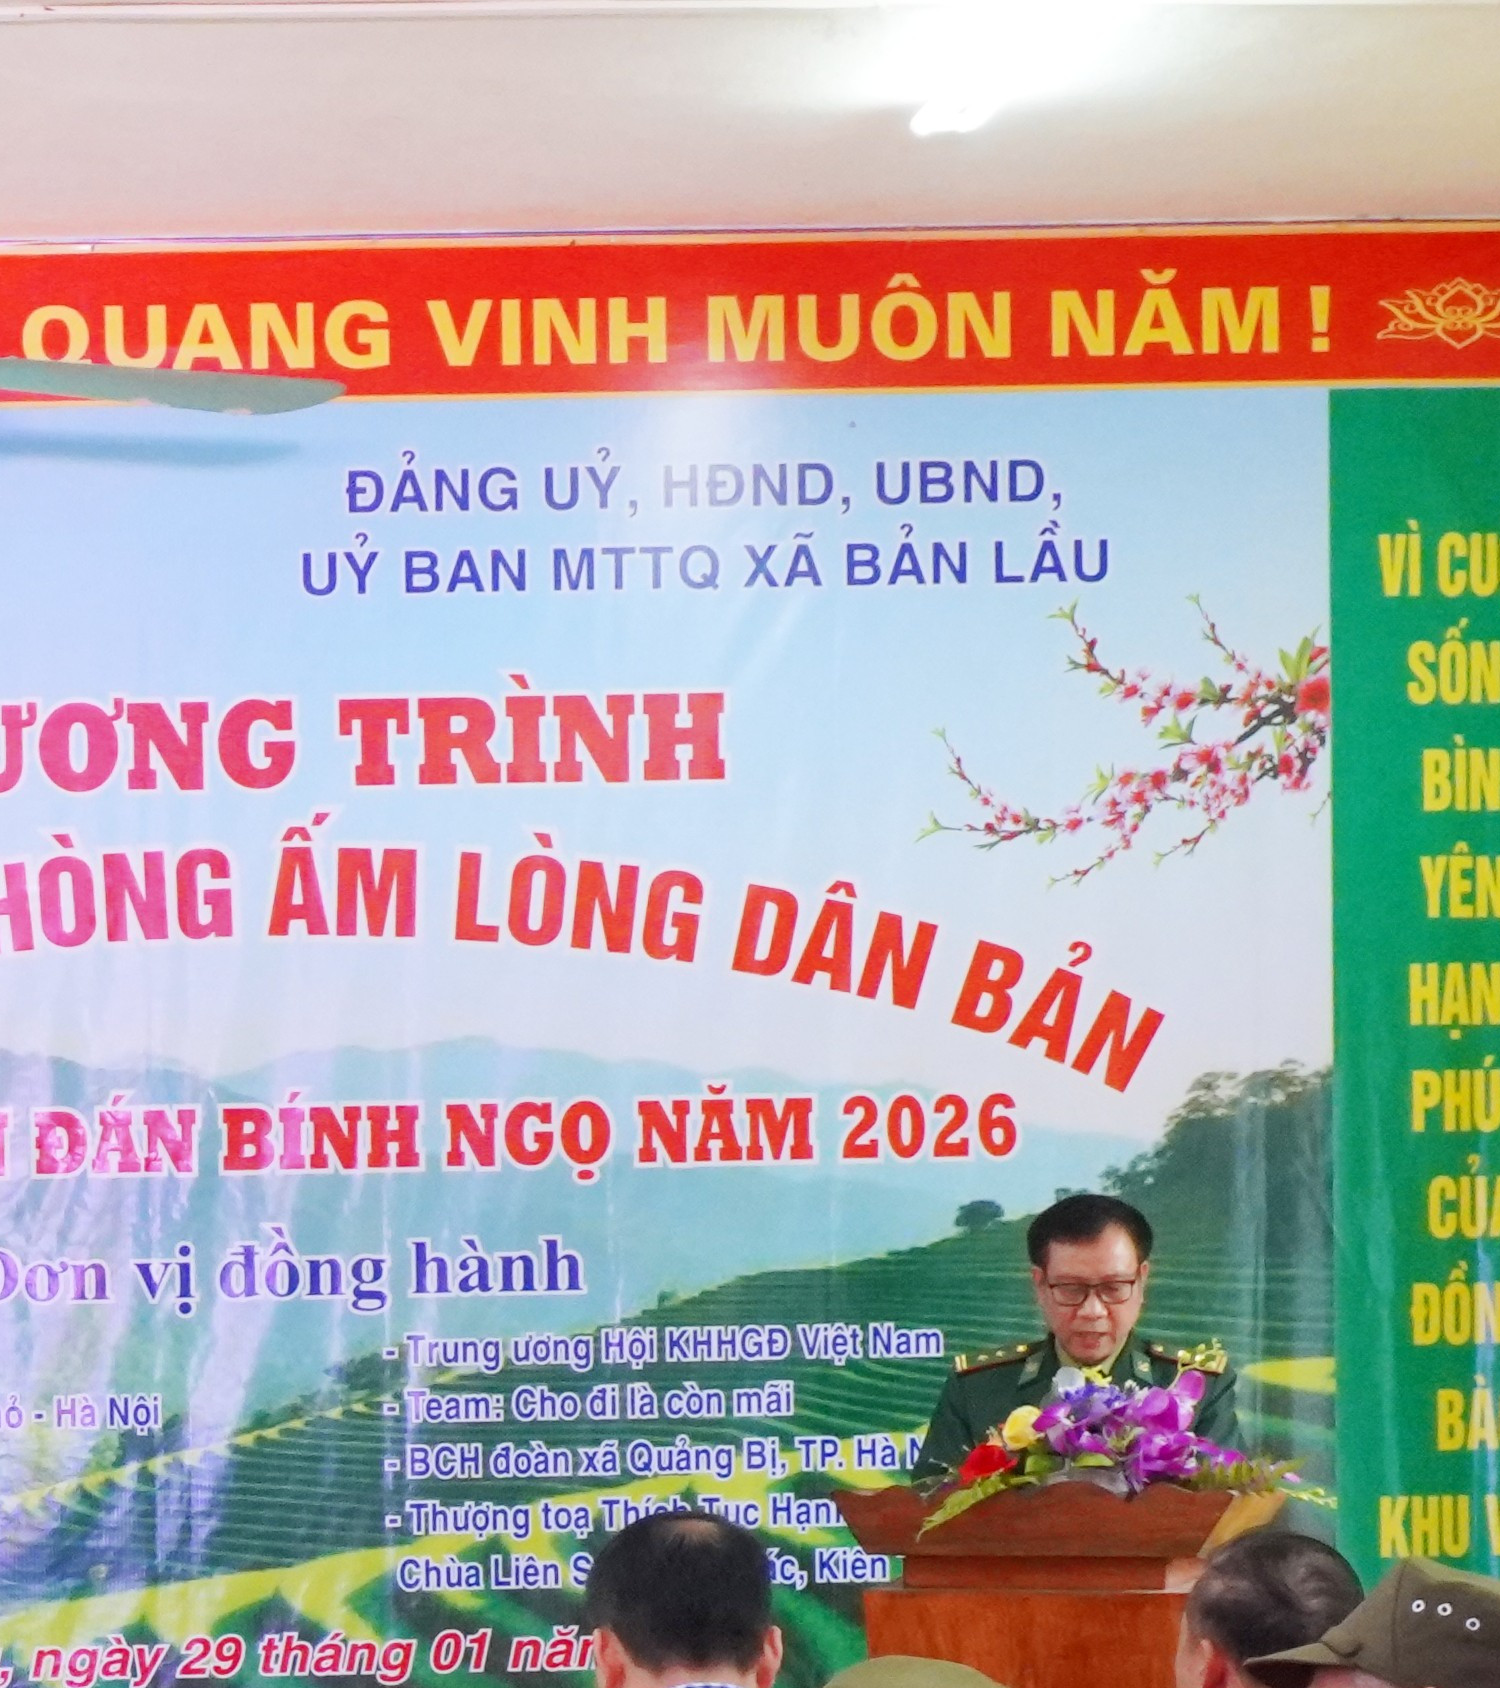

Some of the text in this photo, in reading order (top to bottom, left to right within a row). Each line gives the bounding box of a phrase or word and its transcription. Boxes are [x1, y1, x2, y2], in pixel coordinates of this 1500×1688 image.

[21, 299, 391, 371] QUANG
[427, 296, 668, 367] VINH
[707, 272, 1012, 362] MUÔN
[1051, 268, 1280, 358] NĂM
[345, 449, 1065, 518] ĐẢNG UỶ, HĐND, UBND,
[302, 519, 1110, 596] UỶ BAN MTTQ XÃ BẢN LẦU
[1378, 519, 1422, 598] VÌ
[337, 674, 727, 786] TRÌNH
[268, 811, 417, 938] ẤM
[454, 832, 704, 964] LÒNG
[731, 880, 939, 1012] DÂN
[950, 940, 1166, 1094] BẢN
[34, 1094, 199, 1176] ĐÁN
[222, 1082, 420, 1171] BÍNH
[445, 1102, 611, 1182] NGỌ
[637, 1083, 814, 1162] NĂM
[841, 1093, 1019, 1160] 2026
[135, 1245, 196, 1315] vị
[218, 1226, 388, 1311] đồng
[411, 1238, 585, 1293] hành
[406, 1325, 941, 1371] Trung ương Hội KHHGĐ Việt Nam
[56, 1394, 97, 1428] Hà
[109, 1395, 160, 1433] Nội
[407, 1382, 792, 1420] Team: Cho đi là còn mãi
[410, 1445, 480, 1477] BCH
[493, 1442, 570, 1475] đoàn
[583, 1440, 618, 1474] xã
[630, 1437, 733, 1477] Quảng
[746, 1439, 787, 1476] Bị,
[798, 1438, 844, 1468] TP.
[857, 1437, 896, 1467] Hà
[411, 1495, 843, 1536] Thượng toạ Hạn
[1379, 1494, 1471, 1560] KHU
[400, 1557, 482, 1590] Chùa
[492, 1554, 560, 1588] Liên
[818, 1548, 888, 1580] Kiên
[180, 1636, 242, 1677] 29
[259, 1629, 414, 1684] tháng
[433, 1630, 491, 1672] 01
